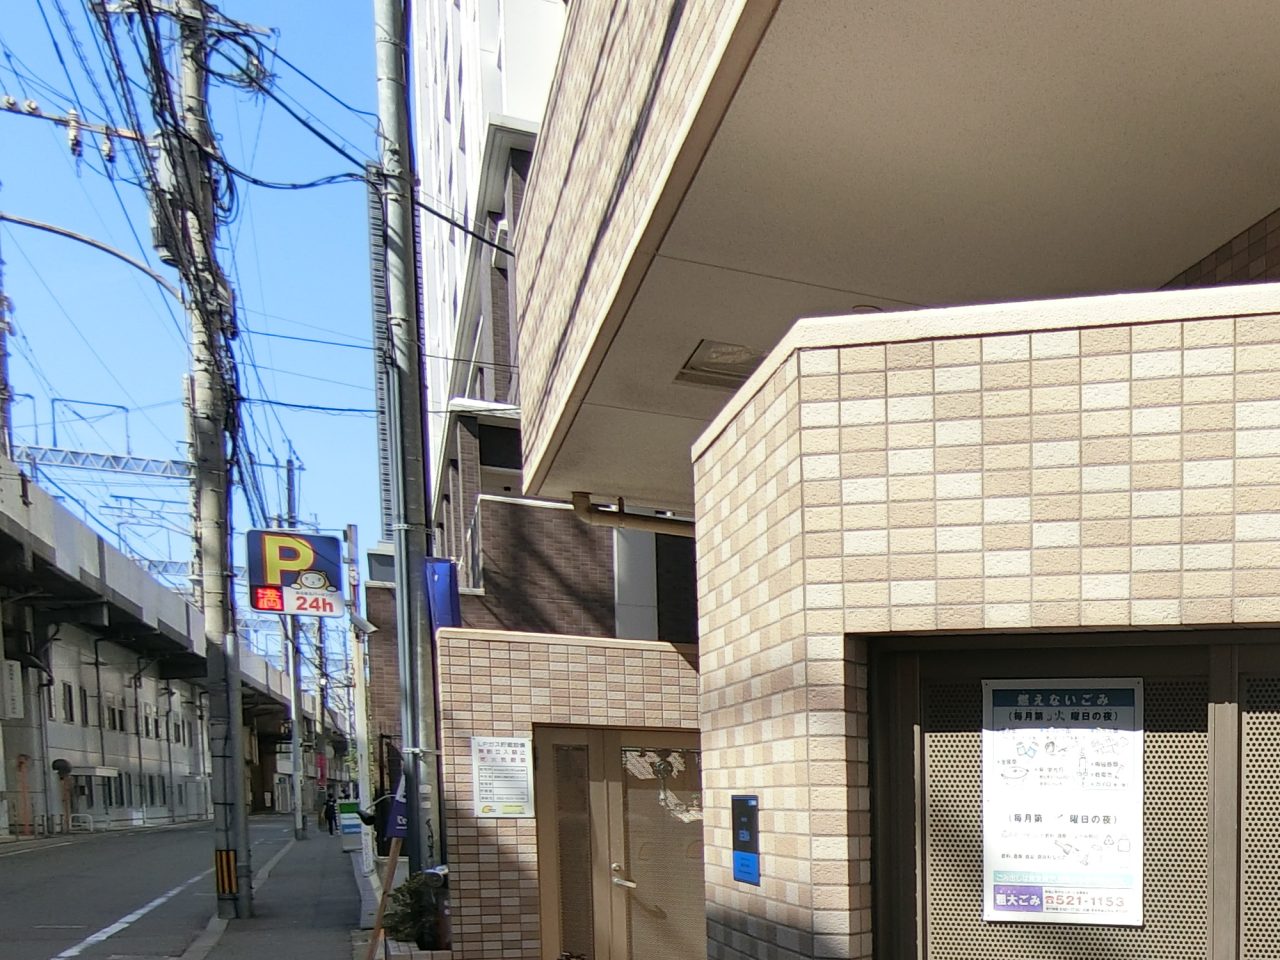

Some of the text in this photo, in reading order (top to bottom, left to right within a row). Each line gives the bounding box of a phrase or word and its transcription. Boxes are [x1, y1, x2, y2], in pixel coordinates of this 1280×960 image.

[262, 533, 315, 585] P
[257, 588, 282, 610] 満
[296, 596, 334, 612] 24h
[1016, 692, 1109, 706] 燃えないごみ
[995, 894, 1041, 906] 粗大ごみ
